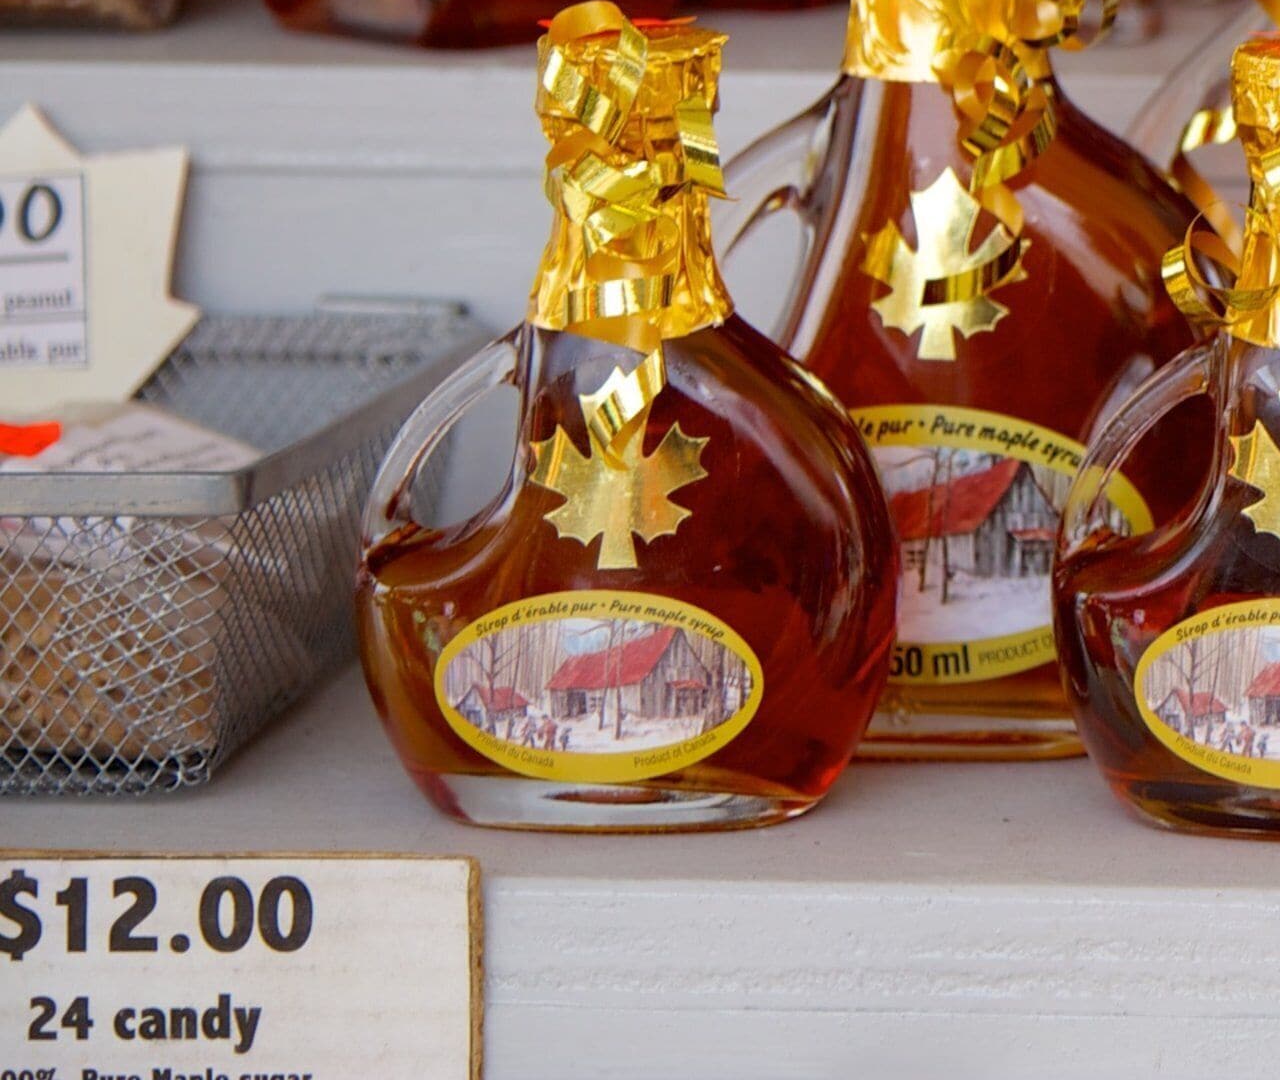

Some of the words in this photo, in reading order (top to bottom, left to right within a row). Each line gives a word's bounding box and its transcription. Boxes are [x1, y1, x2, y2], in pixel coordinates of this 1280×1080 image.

[876, 419, 913, 442] pur
[930, 415, 974, 437] Pure
[978, 426, 1039, 452] maple
[1040, 442, 1081, 467] syru
[475, 615, 509, 638] Sirop
[511, 602, 569, 622] d'érable
[569, 601, 598, 616] pur
[608, 599, 643, 614] Pure
[644, 604, 688, 623] maple
[688, 616, 726, 640] syrup
[1175, 621, 1209, 642] Sirop
[1211, 610, 1269, 630] d'érable
[890, 646, 922, 678] 50
[932, 646, 970, 674] ml
[978, 640, 1040, 666] PRODUCT
[520, 751, 556, 769] Canada
[633, 750, 671, 769] Product
[671, 745, 683, 759] of
[683, 732, 717, 755] Canada
[1219, 756, 1253, 776] Canada
[0, 869, 314, 960] $12.00
[27, 996, 95, 1040] 24
[112, 993, 262, 1054] candy
